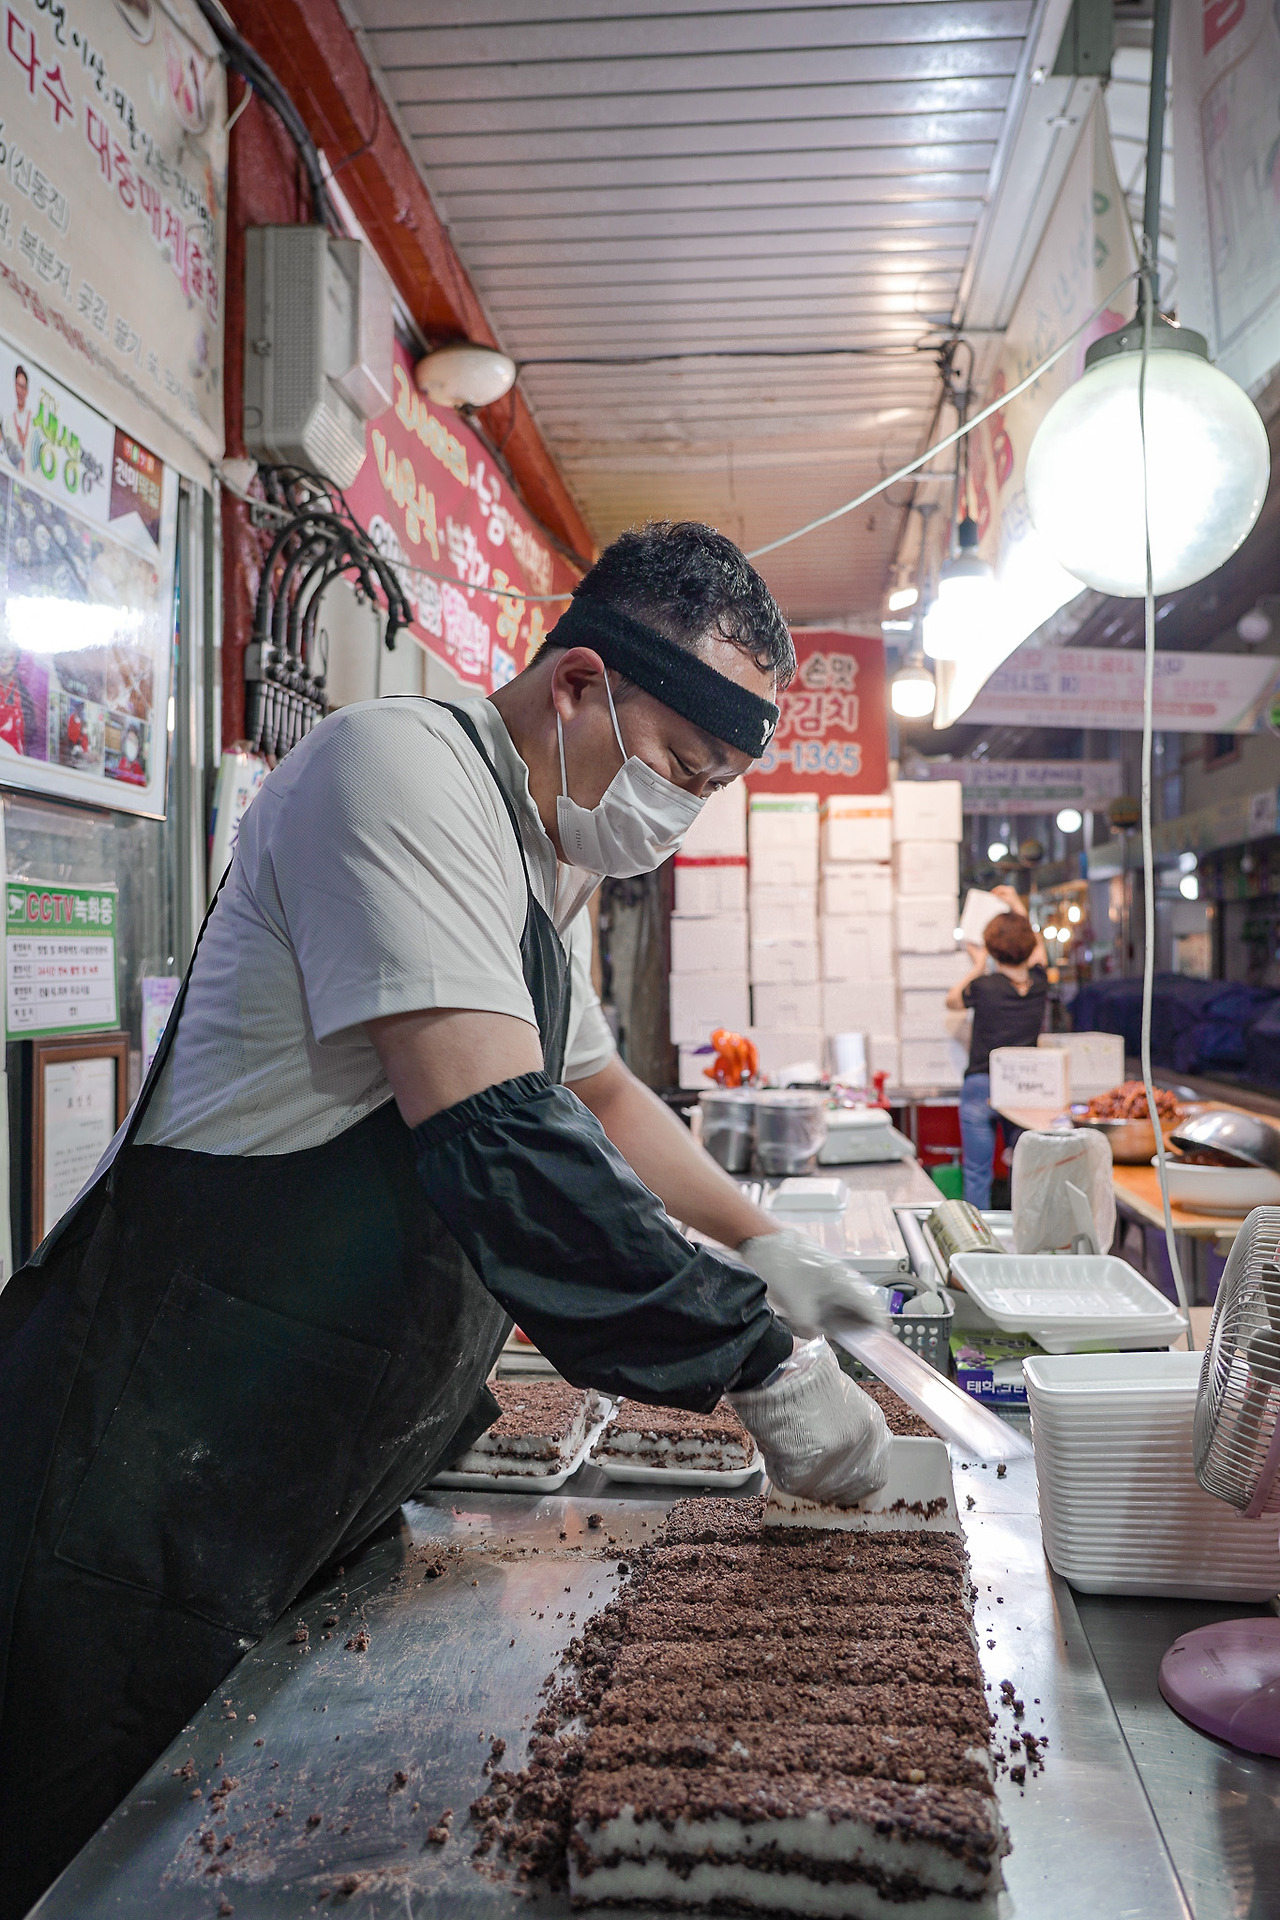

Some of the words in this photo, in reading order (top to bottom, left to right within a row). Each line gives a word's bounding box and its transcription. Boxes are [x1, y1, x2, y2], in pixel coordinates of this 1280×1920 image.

[36, 0, 66, 46] 년
[8, 9, 74, 123] 다수
[751, 741, 860, 776] 5-1365
